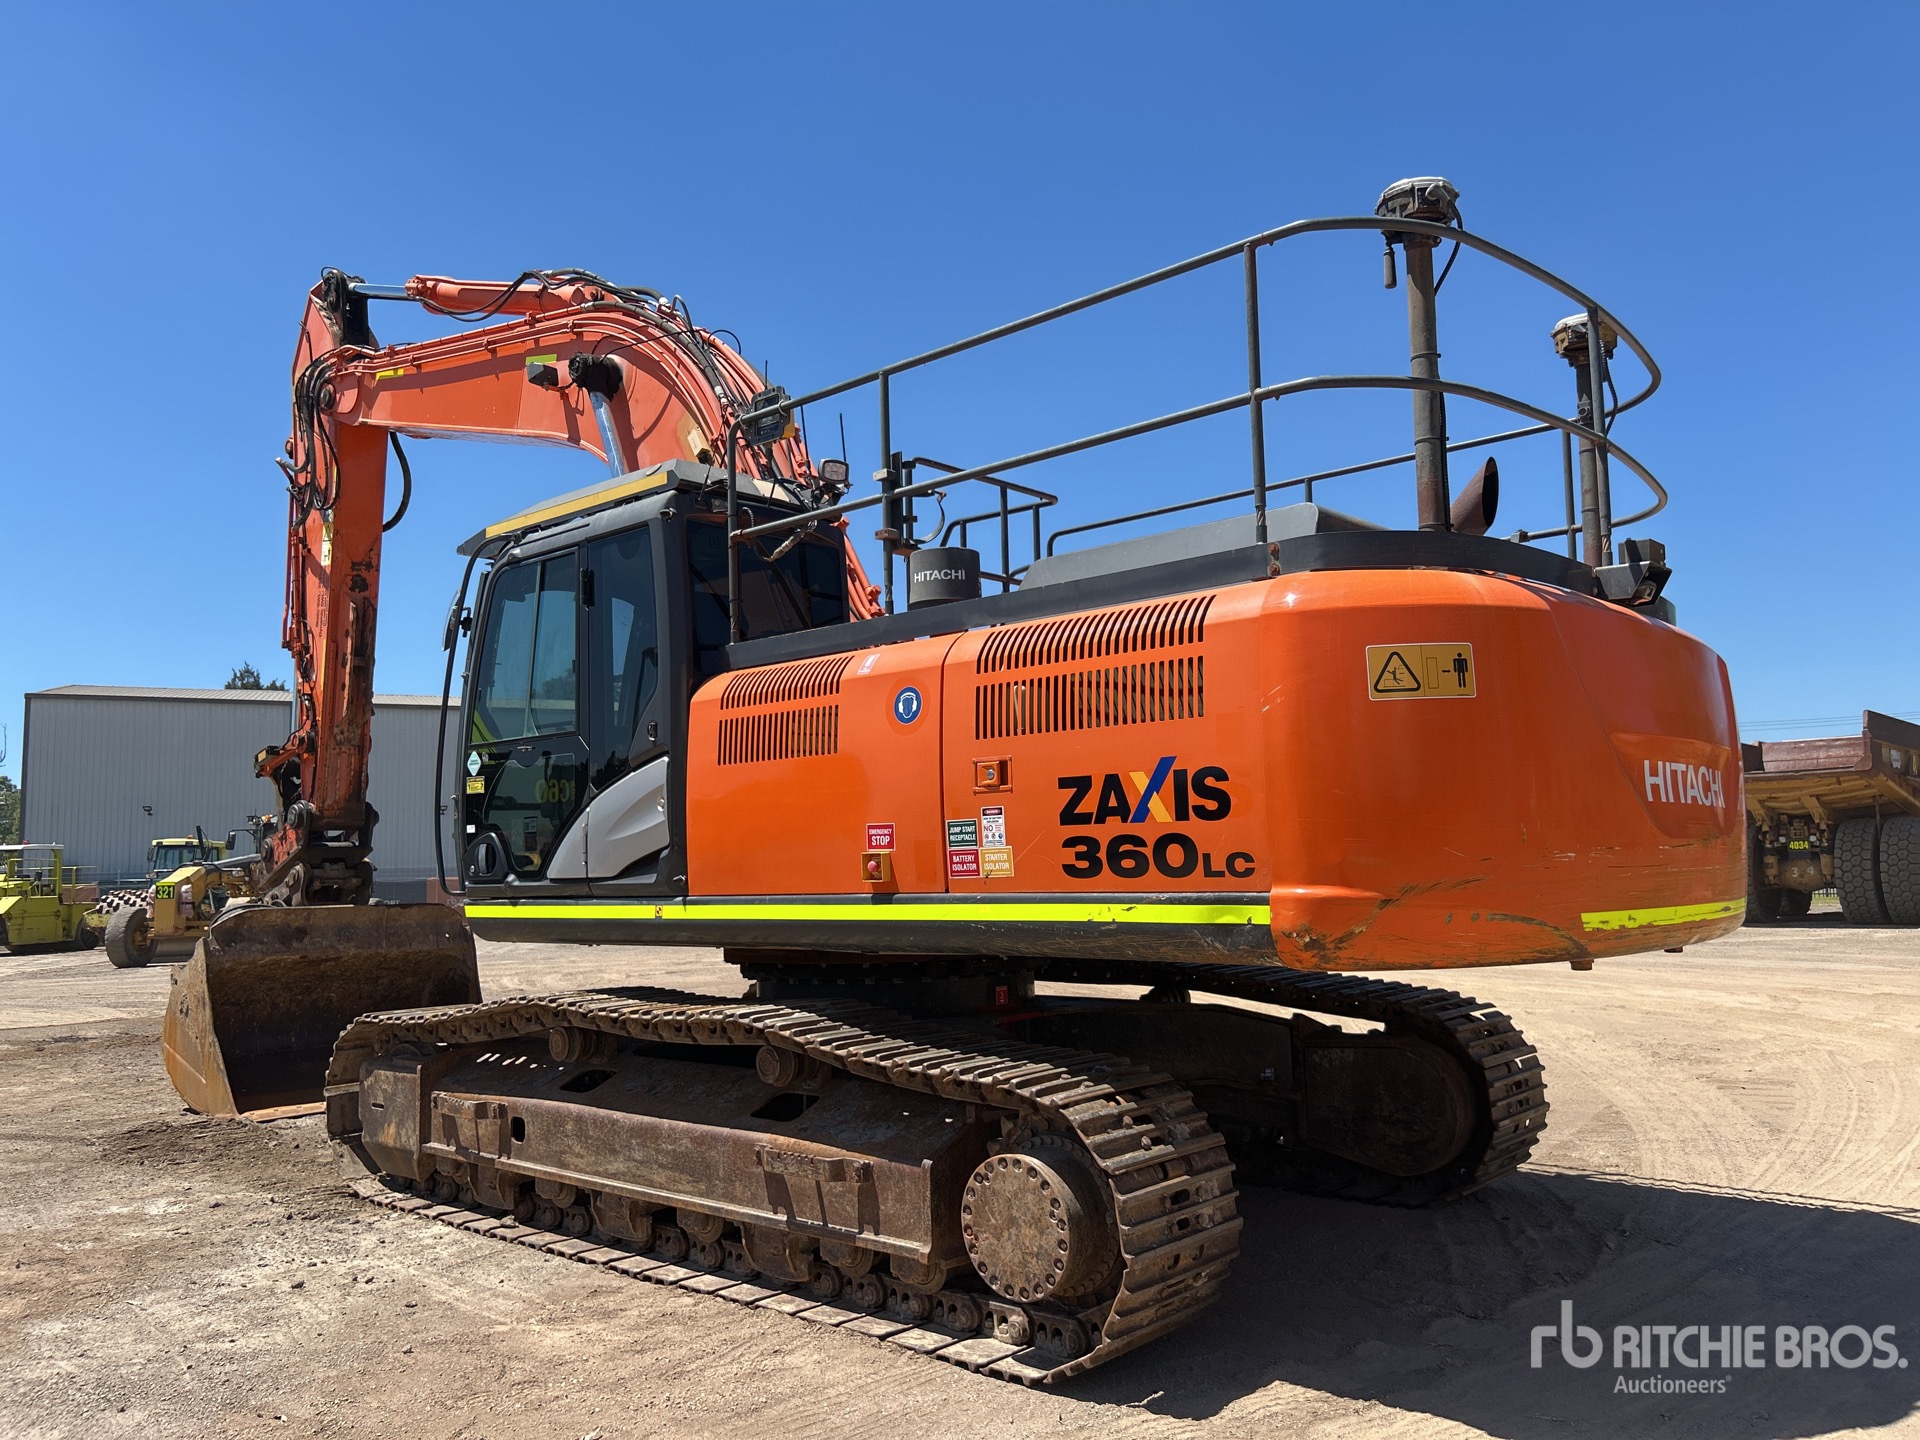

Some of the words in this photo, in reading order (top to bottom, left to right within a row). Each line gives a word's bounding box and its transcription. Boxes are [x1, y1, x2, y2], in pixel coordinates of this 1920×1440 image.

[914, 568, 966, 583] HITACHI
[1644, 759, 1725, 808] HITACHI
[1058, 756, 1231, 826] ZAXIS
[949, 826, 962, 834] JUMP
[962, 825, 976, 833] START
[983, 824, 993, 832] NO
[871, 836, 890, 846] STOP
[950, 833, 976, 842] RECEPTACLE
[1789, 840, 1809, 850] 4034
[953, 855, 975, 863] BATTERY
[985, 853, 1008, 862] STARTER
[952, 863, 977, 871] ISOLATOR
[984, 862, 1010, 870] ISOLATOR
[1791, 867, 1798, 877] 3
[157, 886, 174, 899] 321
